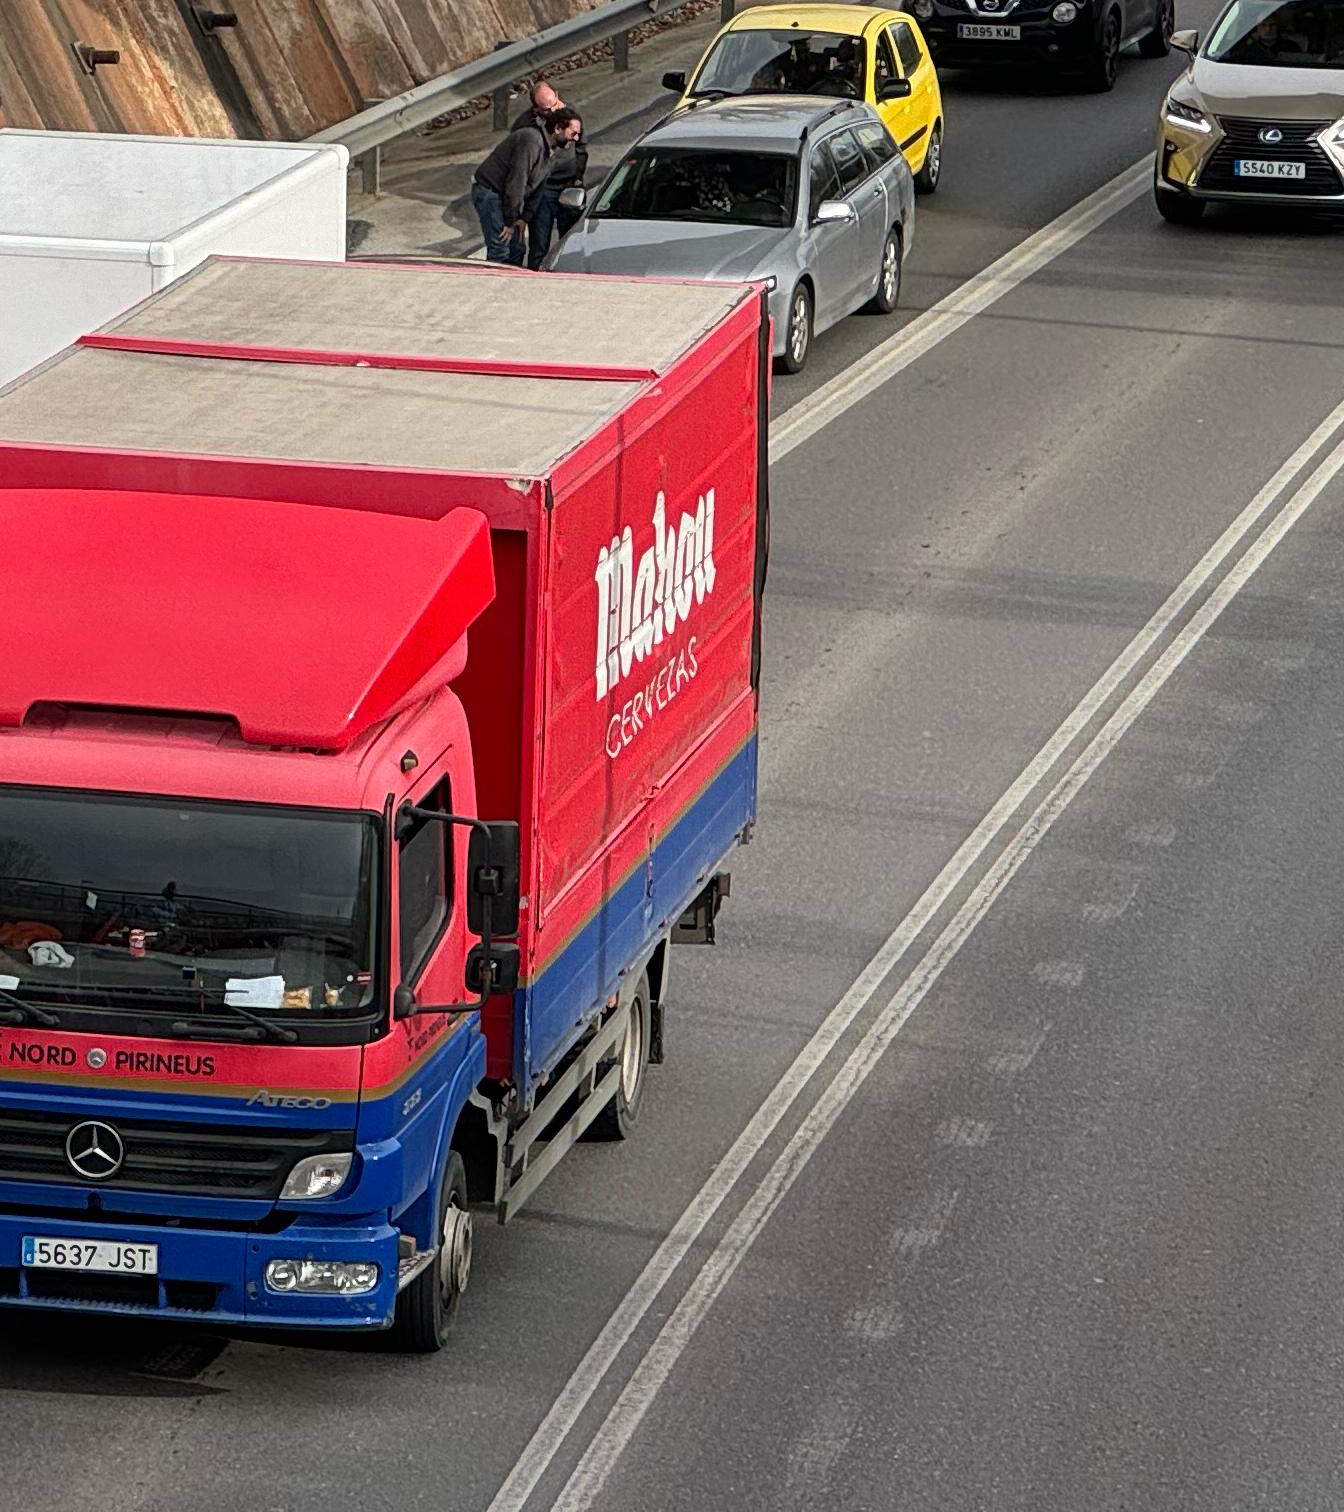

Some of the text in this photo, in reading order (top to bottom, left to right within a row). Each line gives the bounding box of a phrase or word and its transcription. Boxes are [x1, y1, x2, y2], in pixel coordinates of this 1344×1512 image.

[1277, 163, 1302, 176] KZY
[594, 487, 716, 702] Mahou
[605, 636, 699, 759] CERVEZAS
[9, 1042, 77, 1066] NORD
[115, 1050, 216, 1076] PIRINEUS
[38, 1242, 151, 1271] 5637 JST
